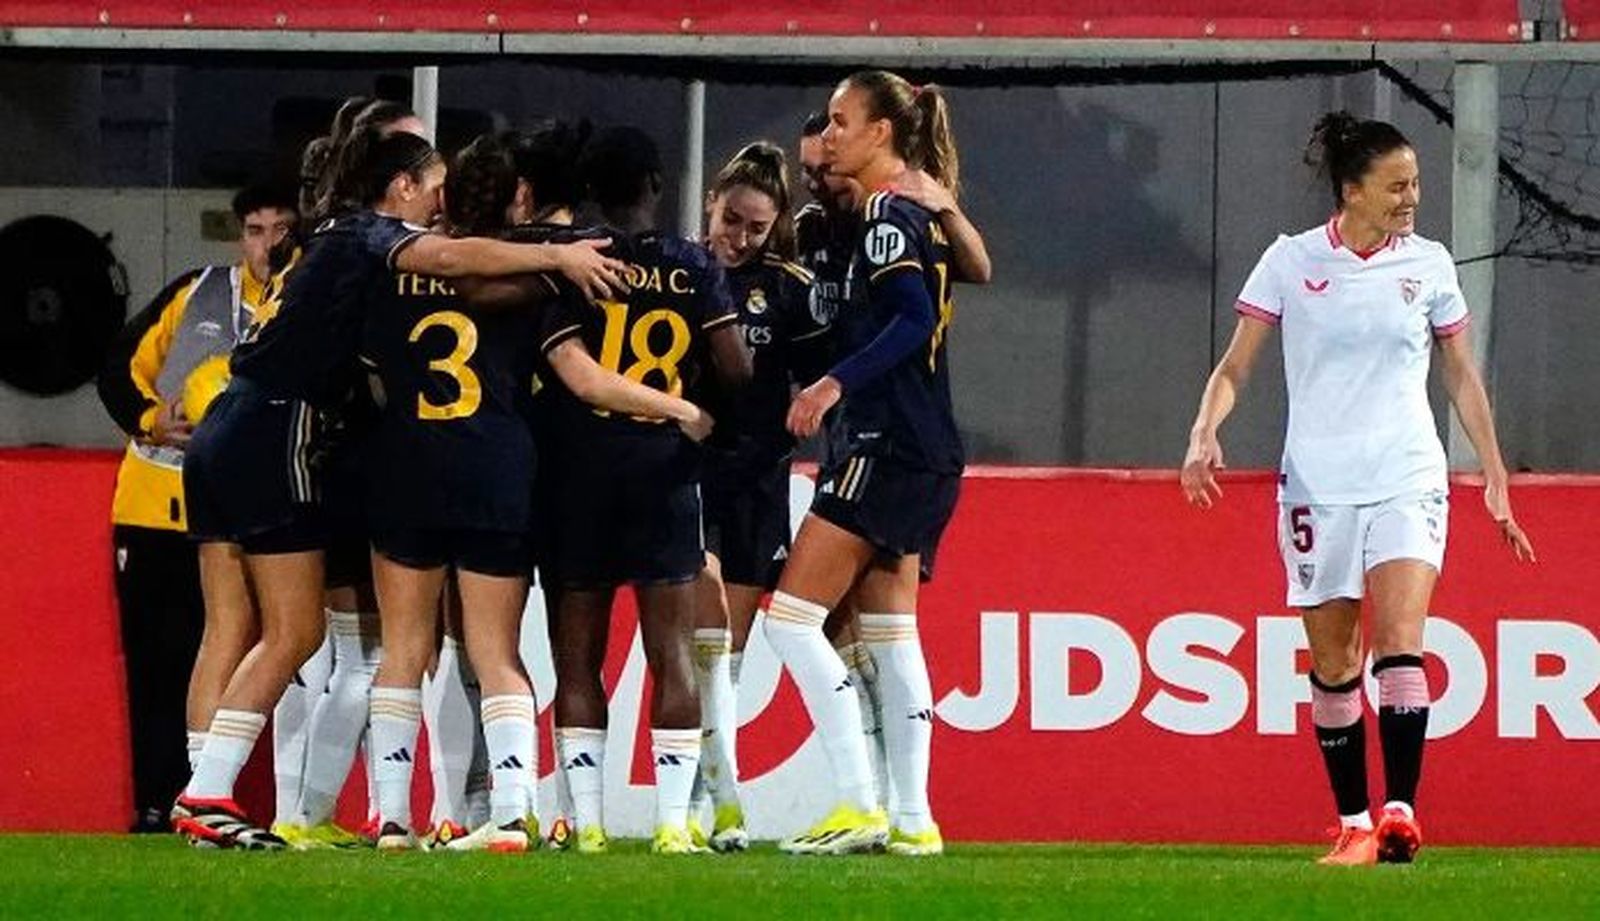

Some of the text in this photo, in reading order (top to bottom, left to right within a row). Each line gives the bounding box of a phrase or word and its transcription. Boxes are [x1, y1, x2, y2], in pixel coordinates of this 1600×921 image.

[871, 226, 899, 264] hp
[669, 268, 695, 294] C.
[408, 311, 482, 420] 3
[594, 300, 692, 423] 18
[1291, 506, 1314, 554] 5
